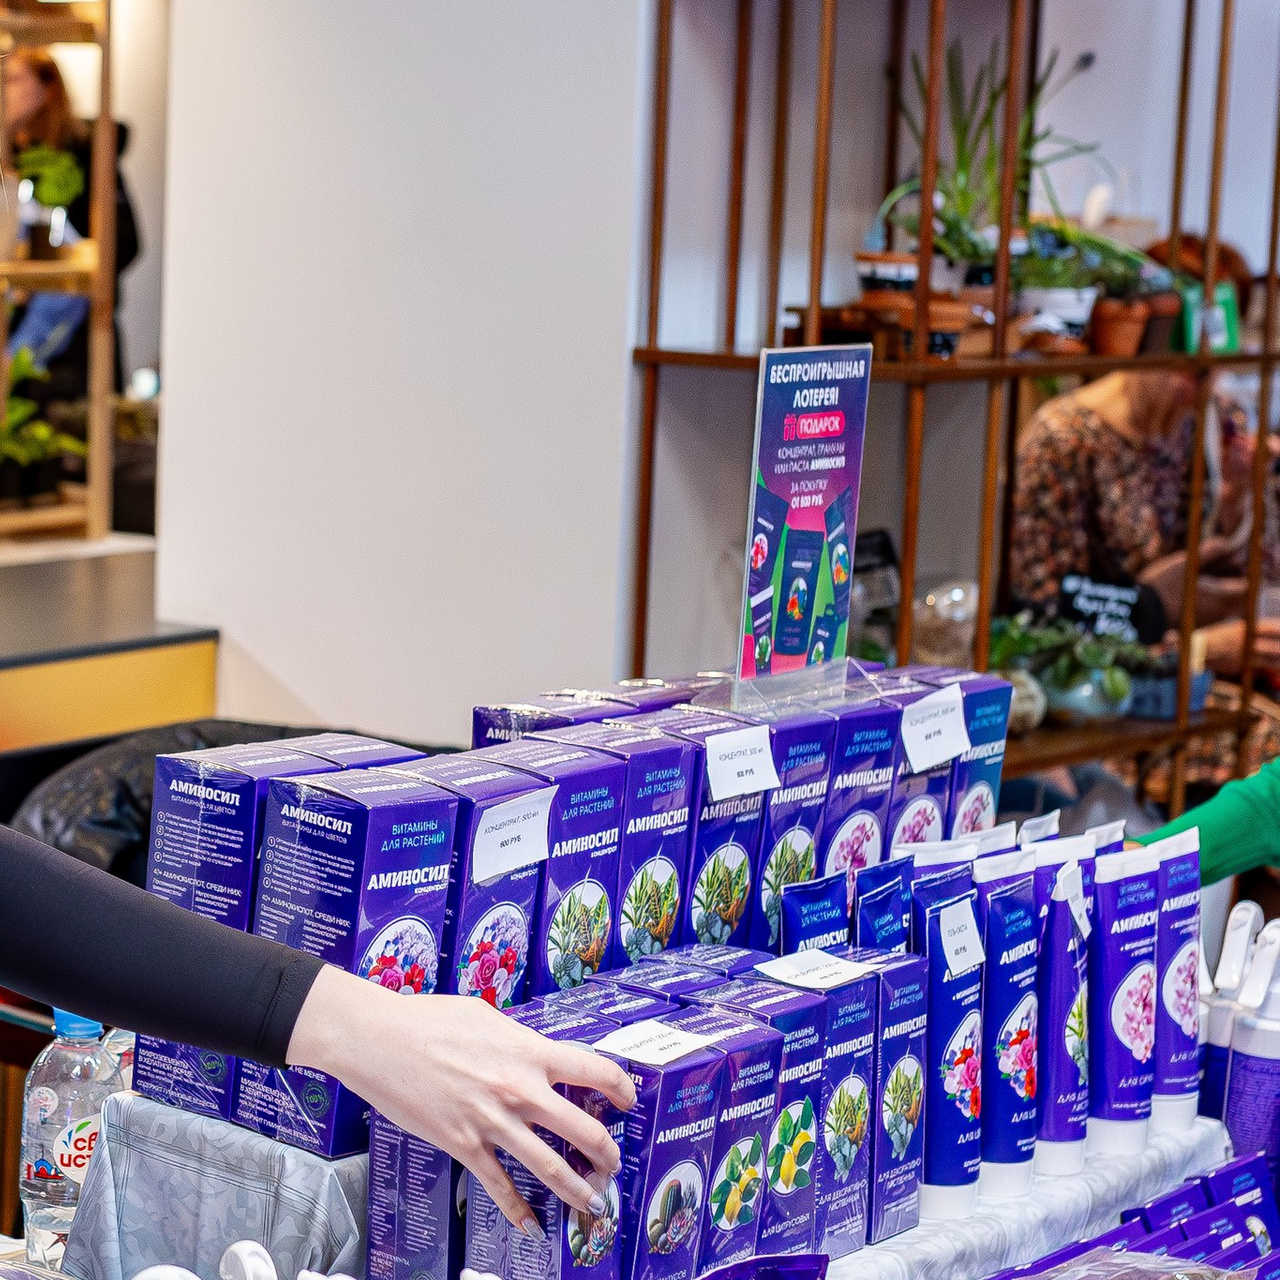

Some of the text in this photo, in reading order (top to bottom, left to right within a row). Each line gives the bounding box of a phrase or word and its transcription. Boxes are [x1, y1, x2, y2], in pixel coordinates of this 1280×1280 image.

[770, 360, 866, 384] БЕСПРОИГРЫШНАЯ
[799, 416, 841, 435] ПОДАРОК
[645, 766, 681, 783] ВИТАМИНЫ
[652, 778, 686, 795] РАСТЕНИЙ
[833, 765, 894, 790] АМИНОСИЛ
[169, 779, 241, 807] АМИНОСИЛ
[570, 786, 609, 804] ВИТАМИНЫ
[769, 780, 828, 807] АМИНОСИЛ
[280, 803, 353, 835] АМИНОСИЛ
[561, 798, 615, 821] ДЛЯ РАСТЕНИЙ
[626, 806, 689, 835] АМИНОСИЛ
[391, 819, 439, 836] ВИТАМИНЫ
[380, 830, 446, 852] ДЛЯ РАСТЕНИЙ
[551, 827, 620, 859] АМИНОСИЛ
[366, 864, 450, 891] АМИНОСИЛ
[882, 1013, 928, 1040] АМИНОСИЛ
[790, 1034, 819, 1052] РАСТЕНИЙ
[825, 1032, 874, 1059] АМИНОСИЛ
[738, 1060, 771, 1079] ВИТАМИНЫ
[745, 1068, 774, 1088] РАСТЕНИЙ
[719, 1093, 776, 1123] АМИНОСИЛ
[655, 1115, 715, 1145] АМИНОСИЛ
